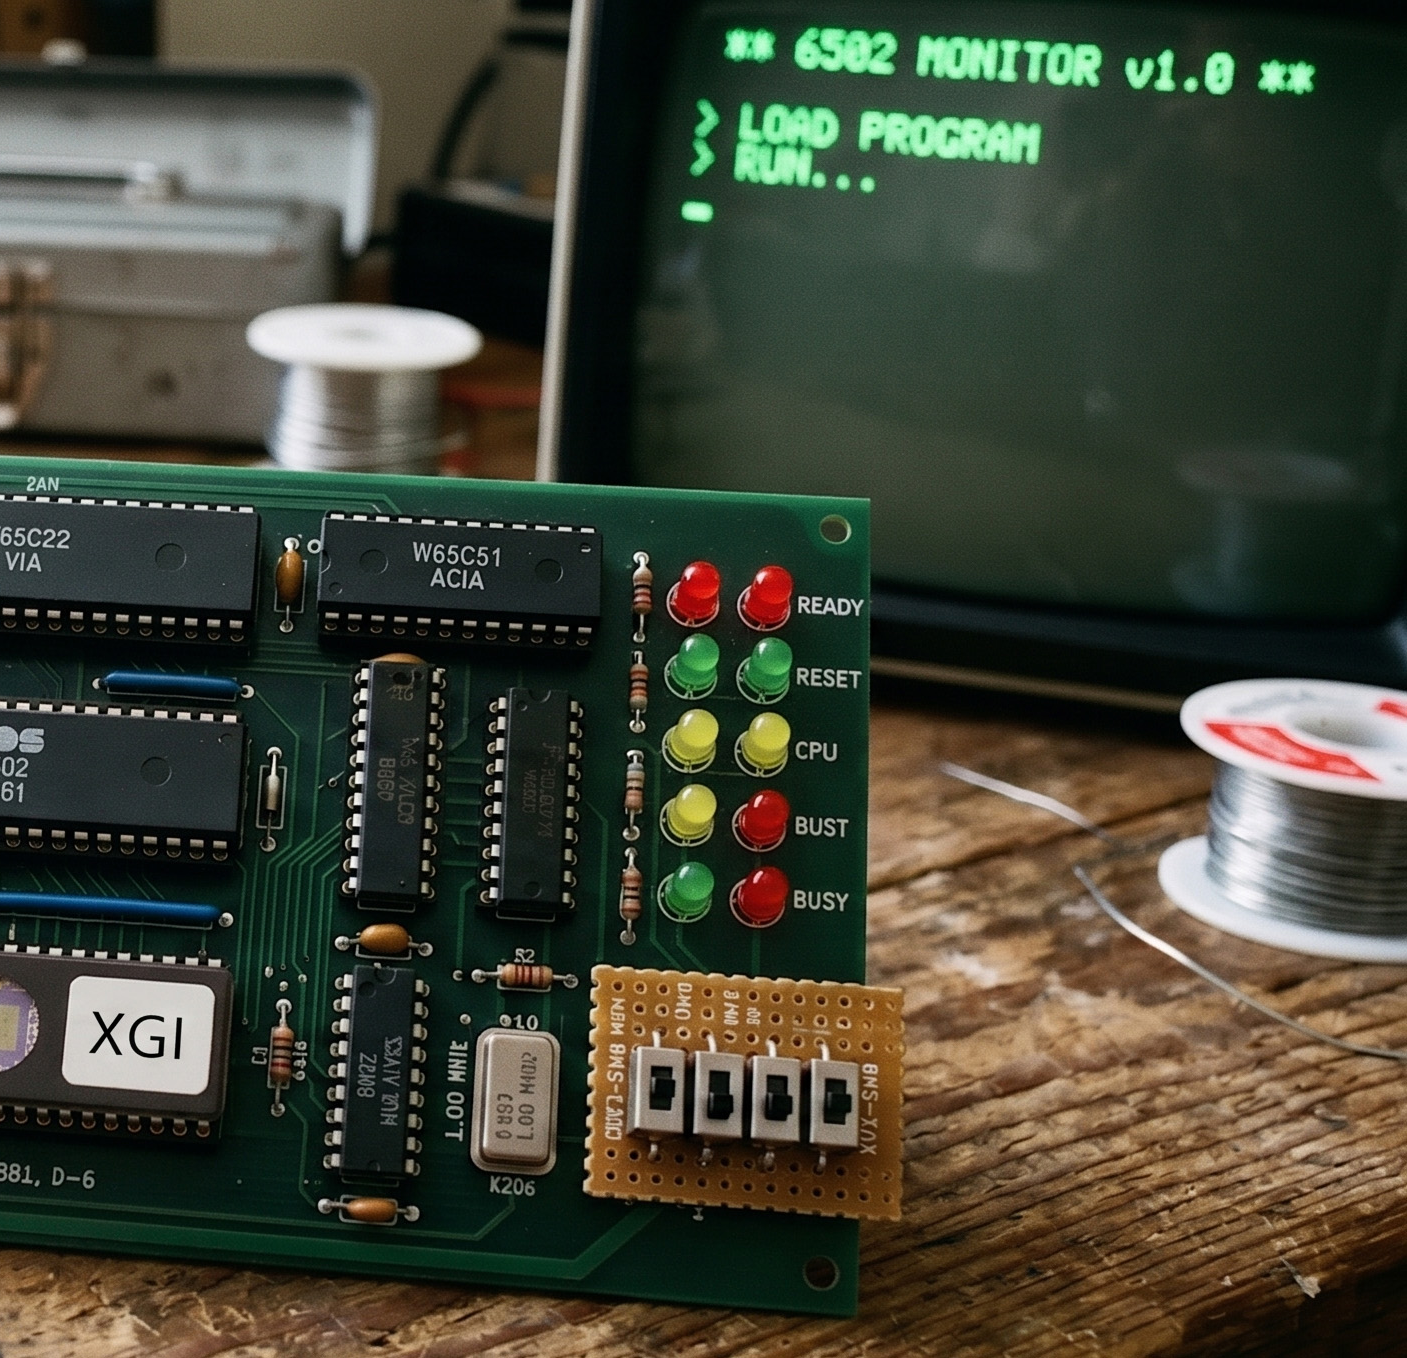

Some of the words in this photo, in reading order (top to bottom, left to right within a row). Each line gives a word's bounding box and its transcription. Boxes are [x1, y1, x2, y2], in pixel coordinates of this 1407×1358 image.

[793, 27, 897, 75] 6502
[916, 35, 1102, 88] MONITOR
[1125, 49, 1235, 94] v1.0
[738, 102, 840, 149] LOAD
[858, 110, 1042, 165] PROGRAM
[26, 476, 60, 493] 2AN
[5, 552, 42, 573] VIA
[412, 541, 502, 568] W65C51
[430, 567, 485, 591] ACIA
[796, 596, 865, 618] READY
[795, 667, 862, 690] RESET
[794, 741, 838, 762] CPU
[794, 816, 850, 838] BUST
[793, 890, 849, 912] BUSY
[89, 1010, 183, 1061] XGI
[51, 1168, 96, 1189] D-6
[489, 1175, 536, 1197] K206
